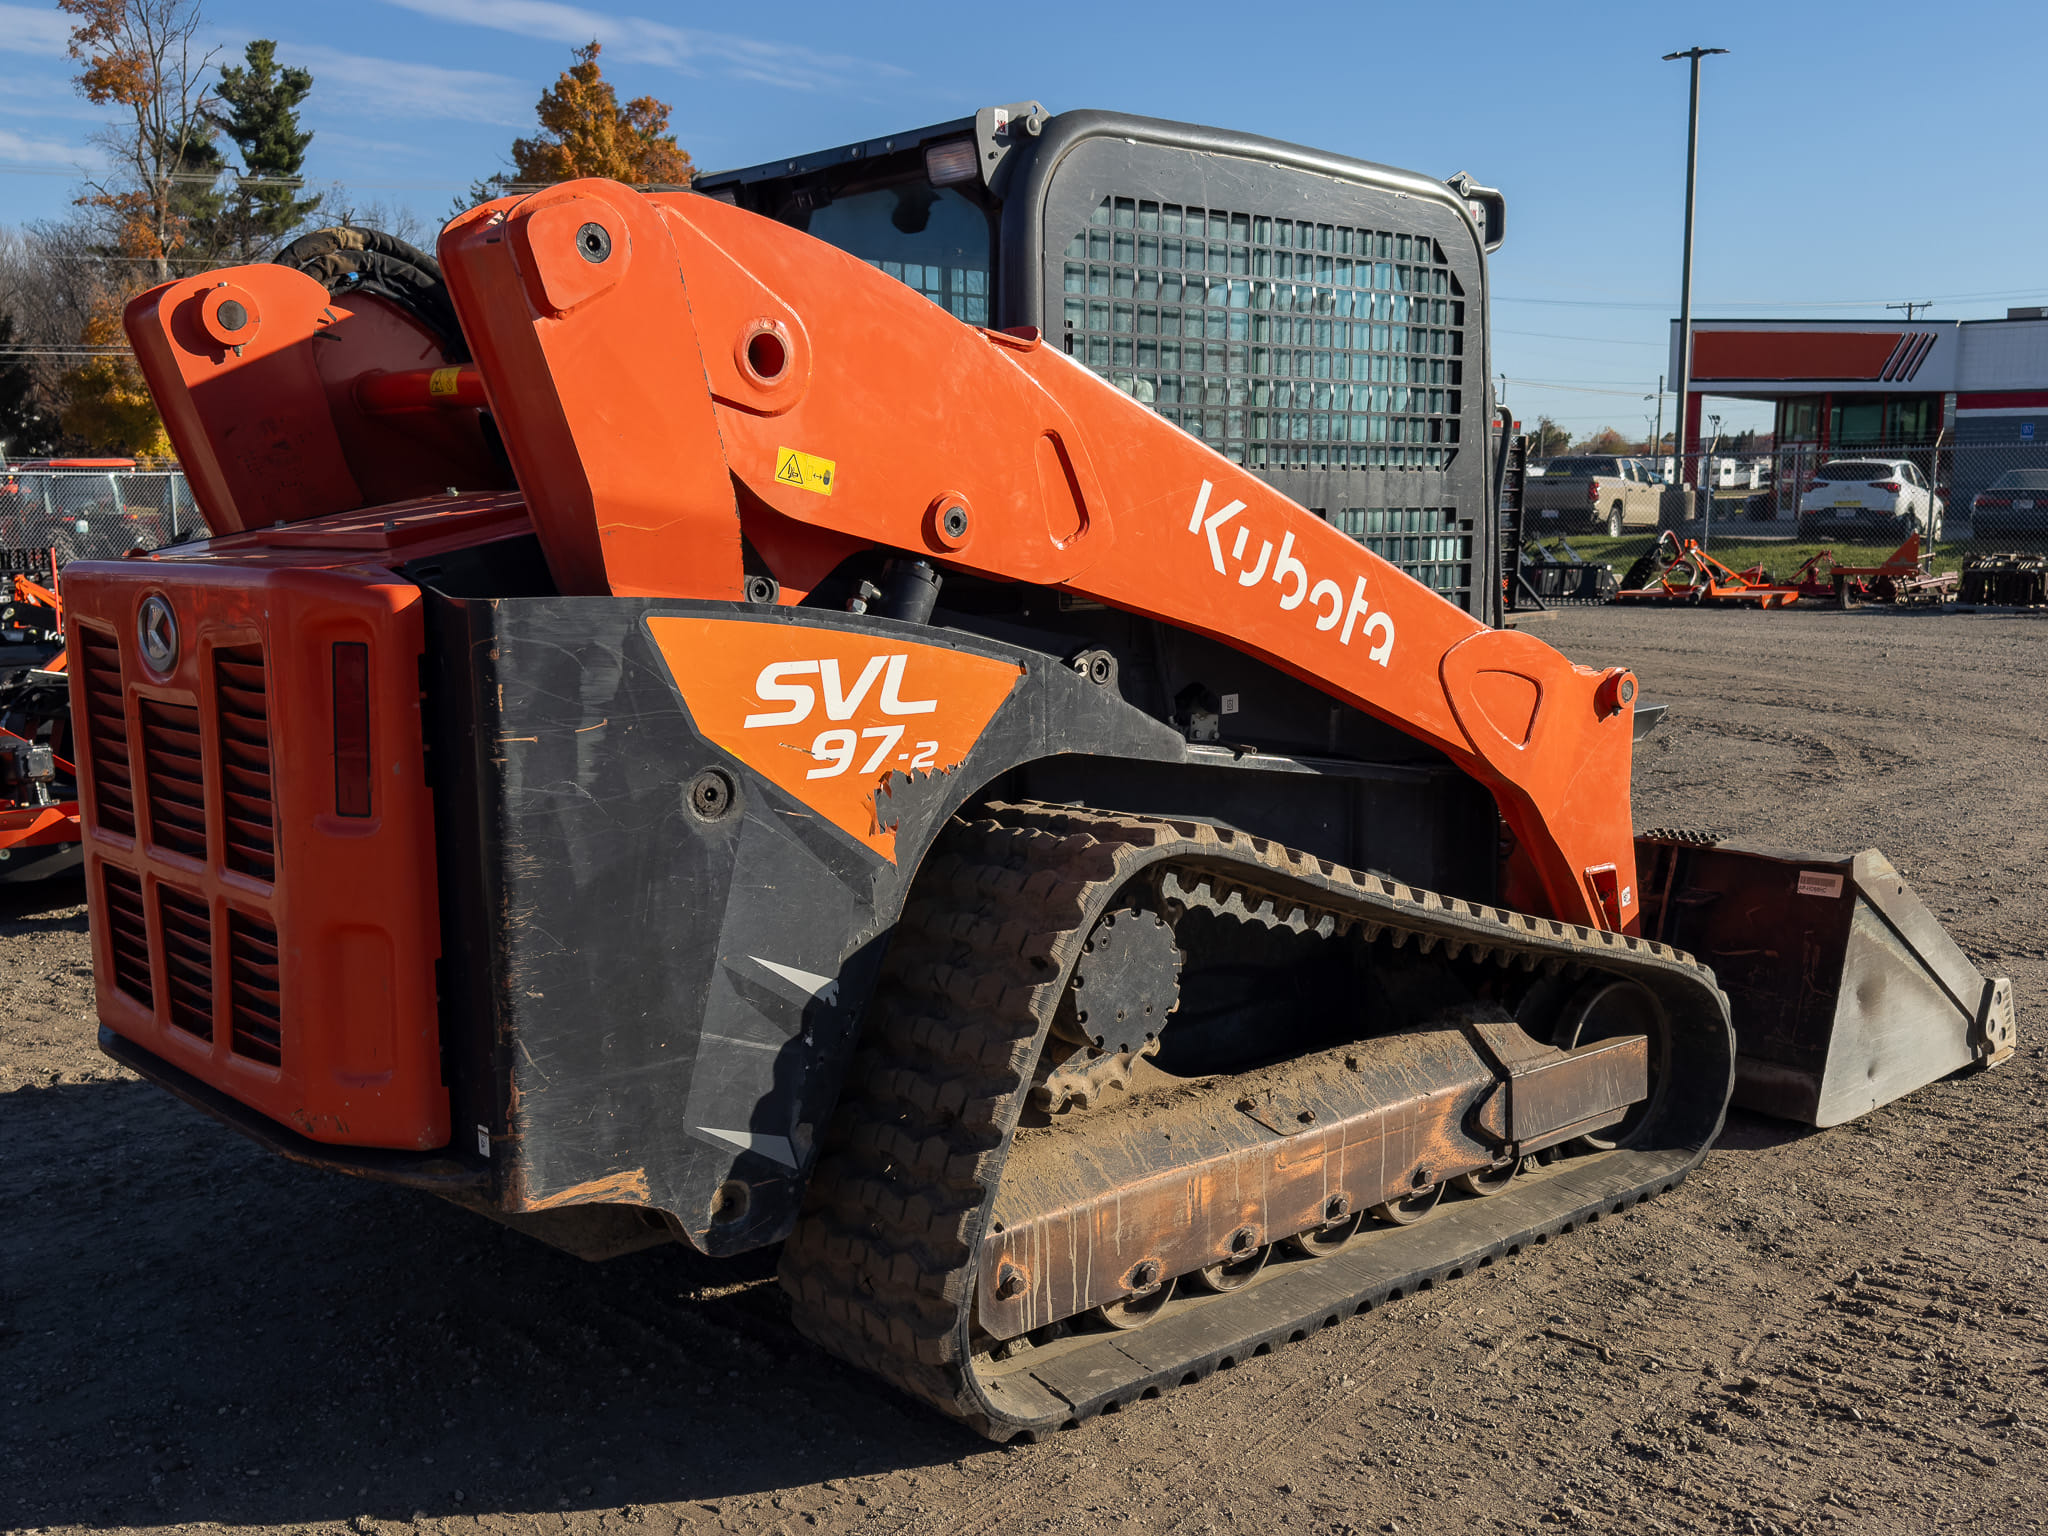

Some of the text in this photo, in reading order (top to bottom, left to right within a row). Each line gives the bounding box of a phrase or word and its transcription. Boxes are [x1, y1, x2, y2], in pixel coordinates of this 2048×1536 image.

[1187, 478, 1396, 669] Kubota
[743, 653, 938, 729] SVL
[805, 724, 939, 780] 97-2
